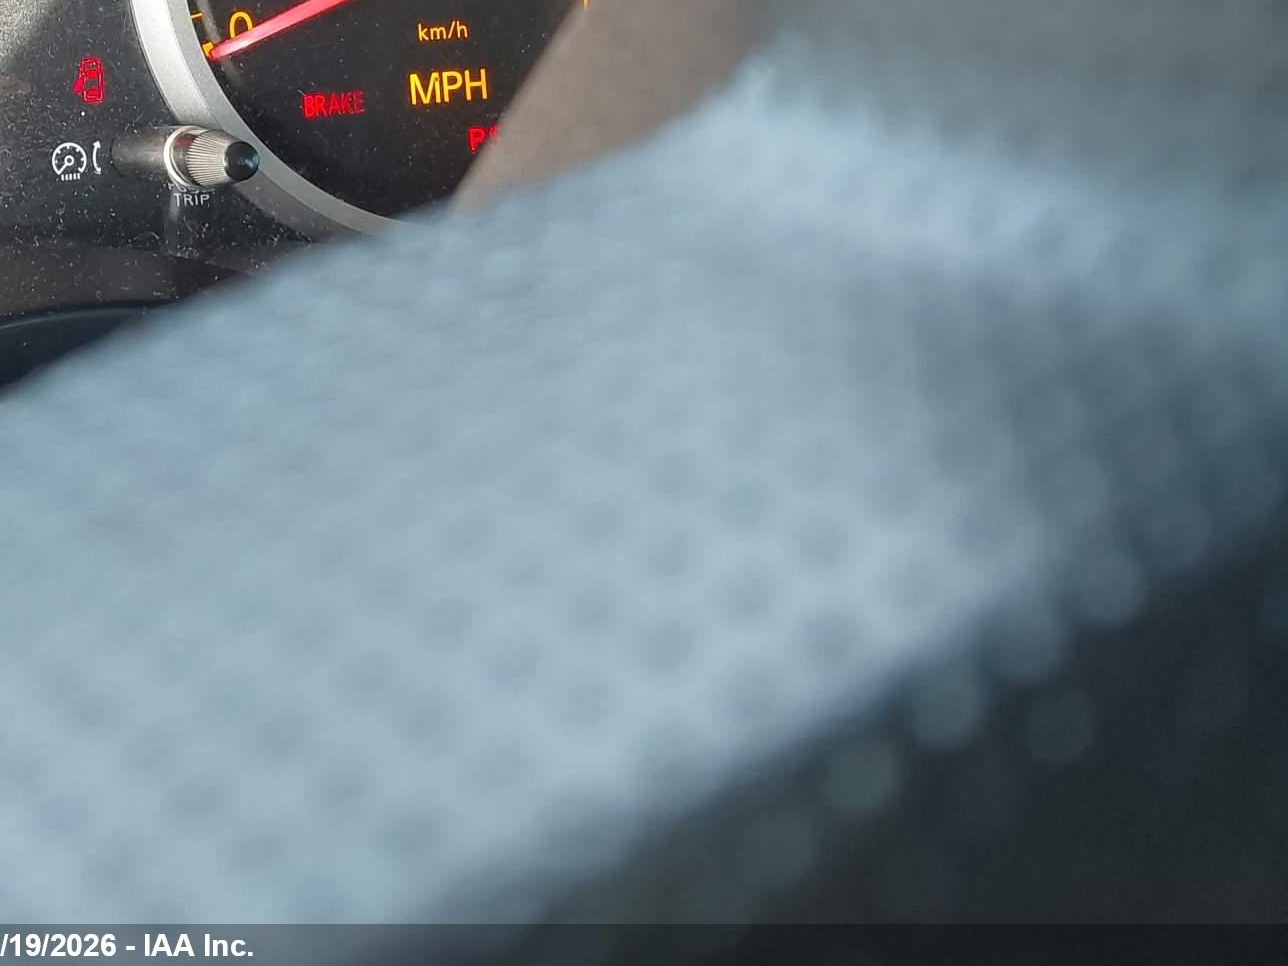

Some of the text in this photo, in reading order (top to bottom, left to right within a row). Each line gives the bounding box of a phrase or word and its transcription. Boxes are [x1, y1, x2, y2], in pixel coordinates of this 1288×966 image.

[417, 19, 468, 42] km/h
[409, 67, 489, 106] MPH
[303, 90, 365, 119] BRAKE
[173, 192, 210, 207] TRIP
